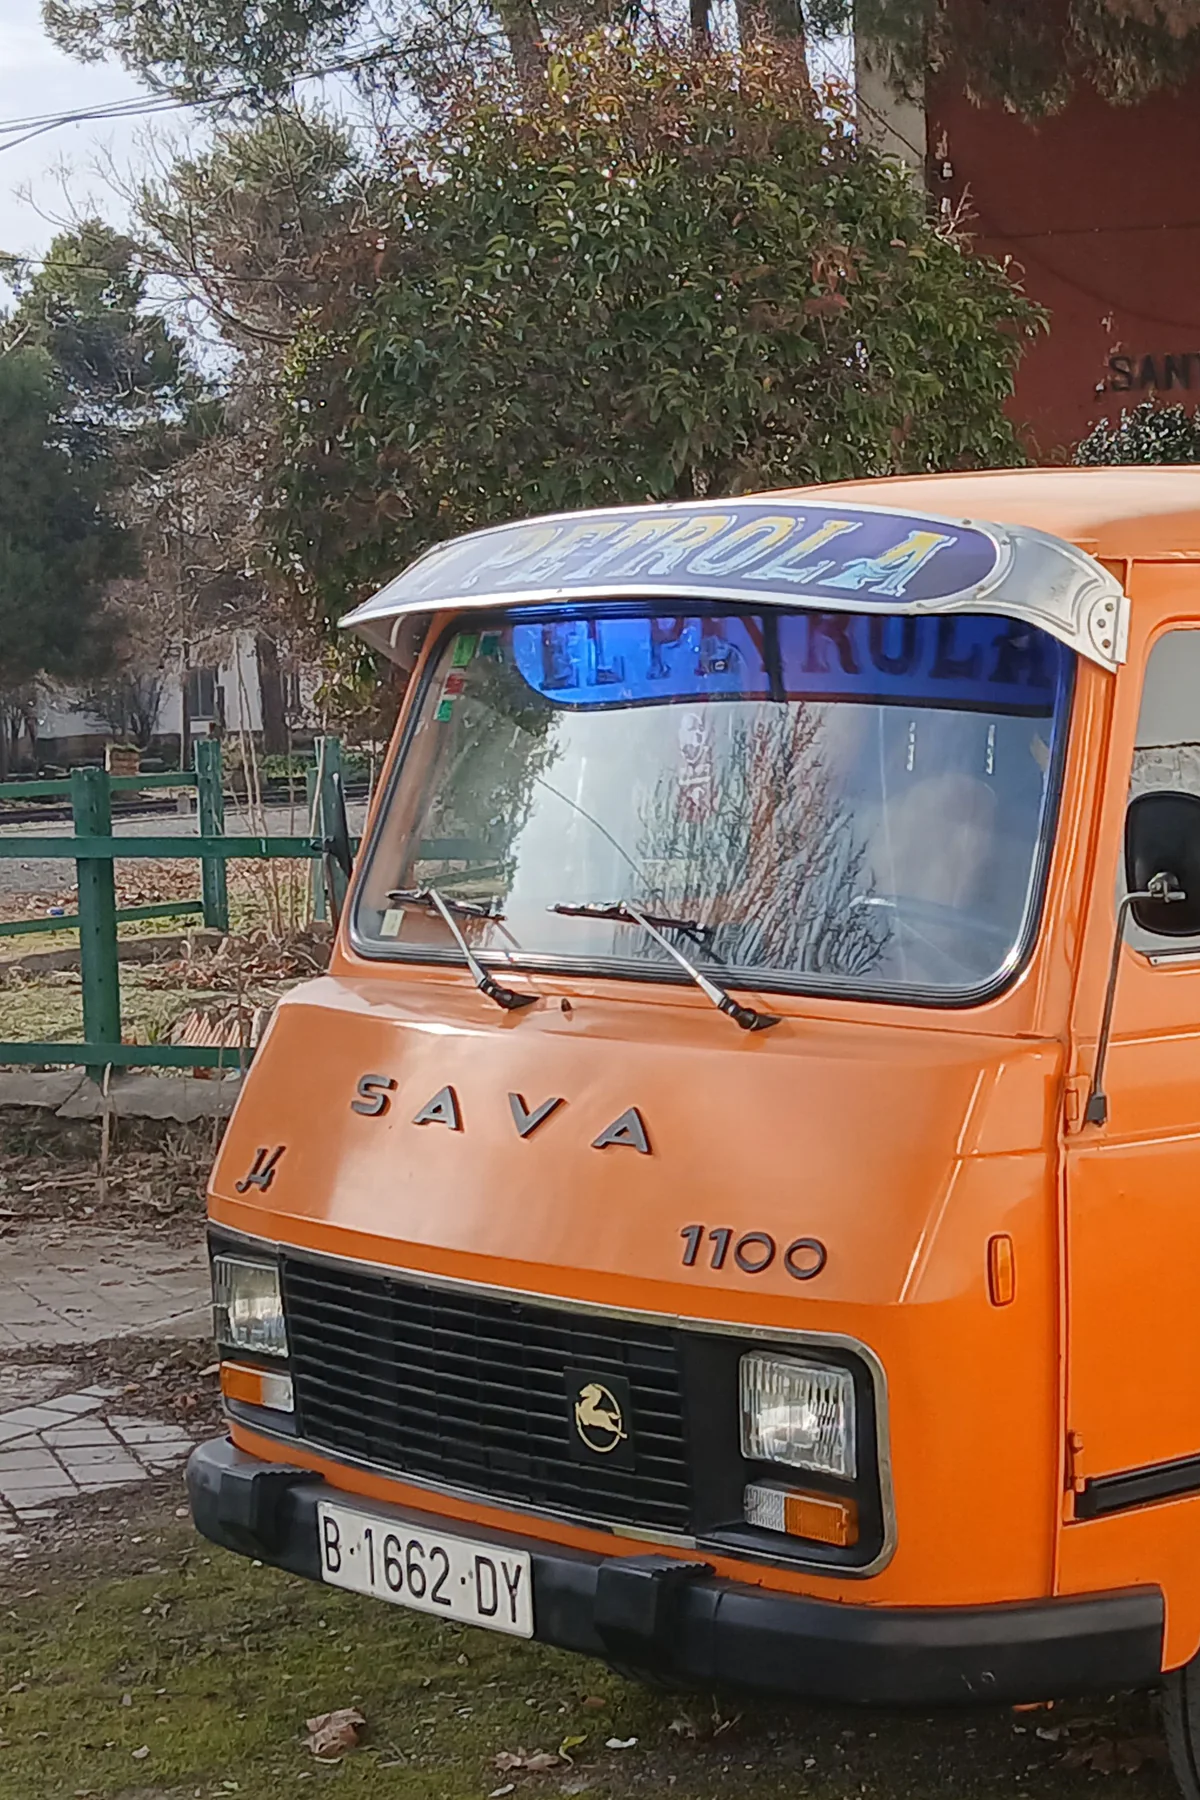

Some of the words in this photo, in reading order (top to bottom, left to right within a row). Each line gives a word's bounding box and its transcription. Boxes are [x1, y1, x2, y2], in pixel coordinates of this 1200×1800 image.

[460, 514, 958, 597] PETROLA
[350, 1072, 656, 1156] SAVA
[680, 1222, 828, 1282] 1100
